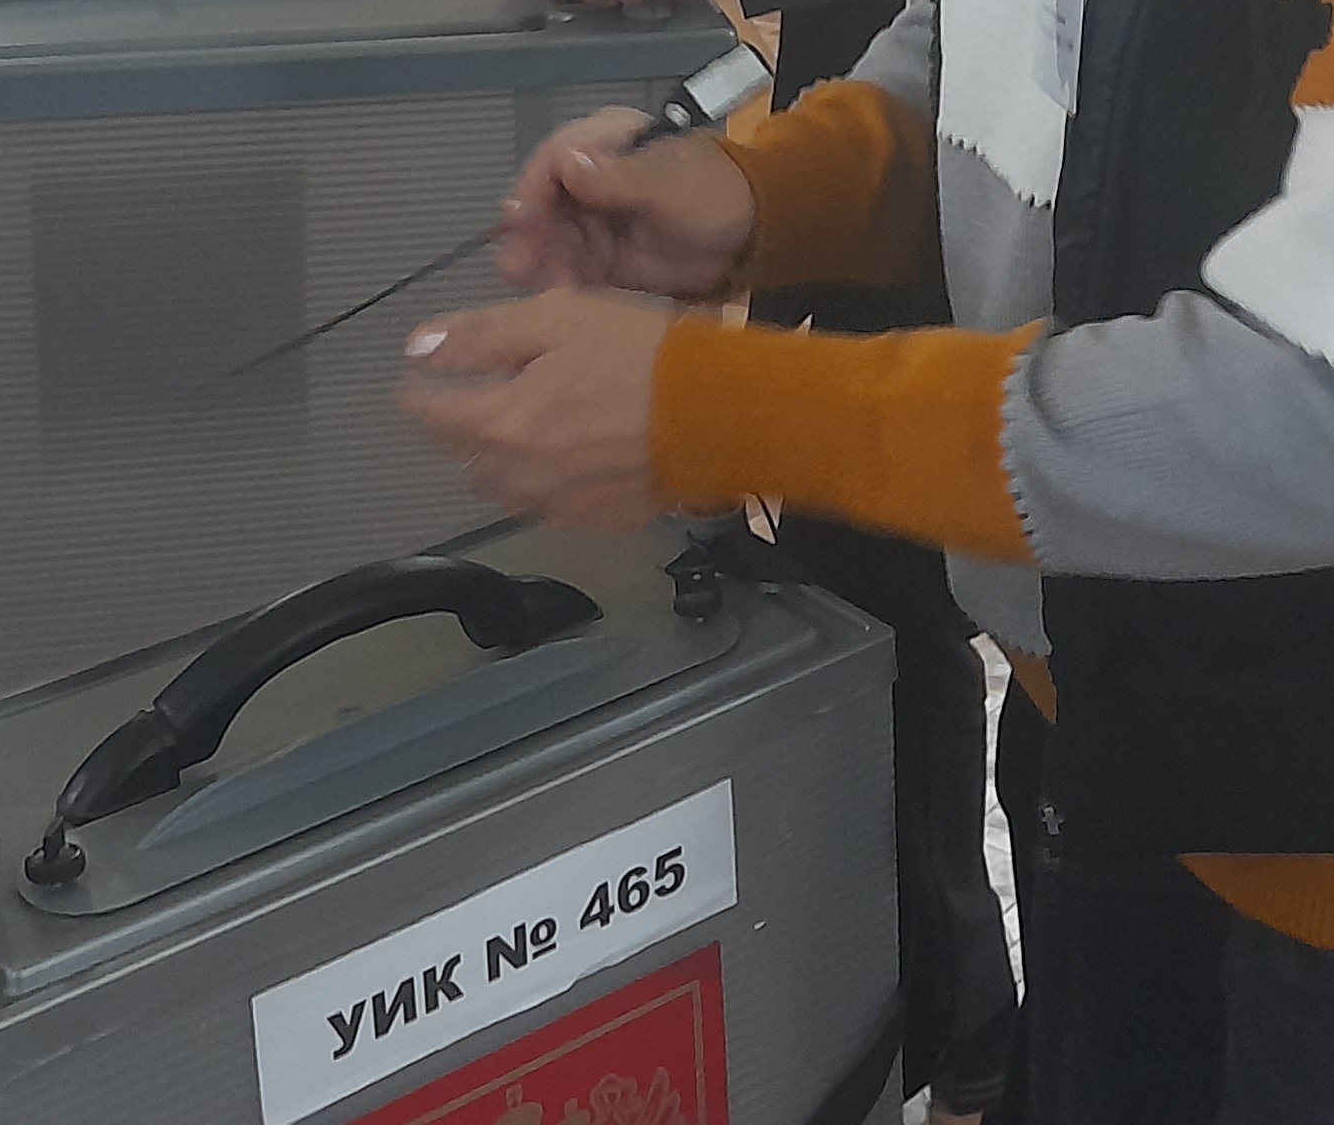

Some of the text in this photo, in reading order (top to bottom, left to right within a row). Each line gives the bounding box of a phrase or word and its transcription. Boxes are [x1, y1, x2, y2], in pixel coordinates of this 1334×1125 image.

[326, 846, 685, 1060] УИК № 465
